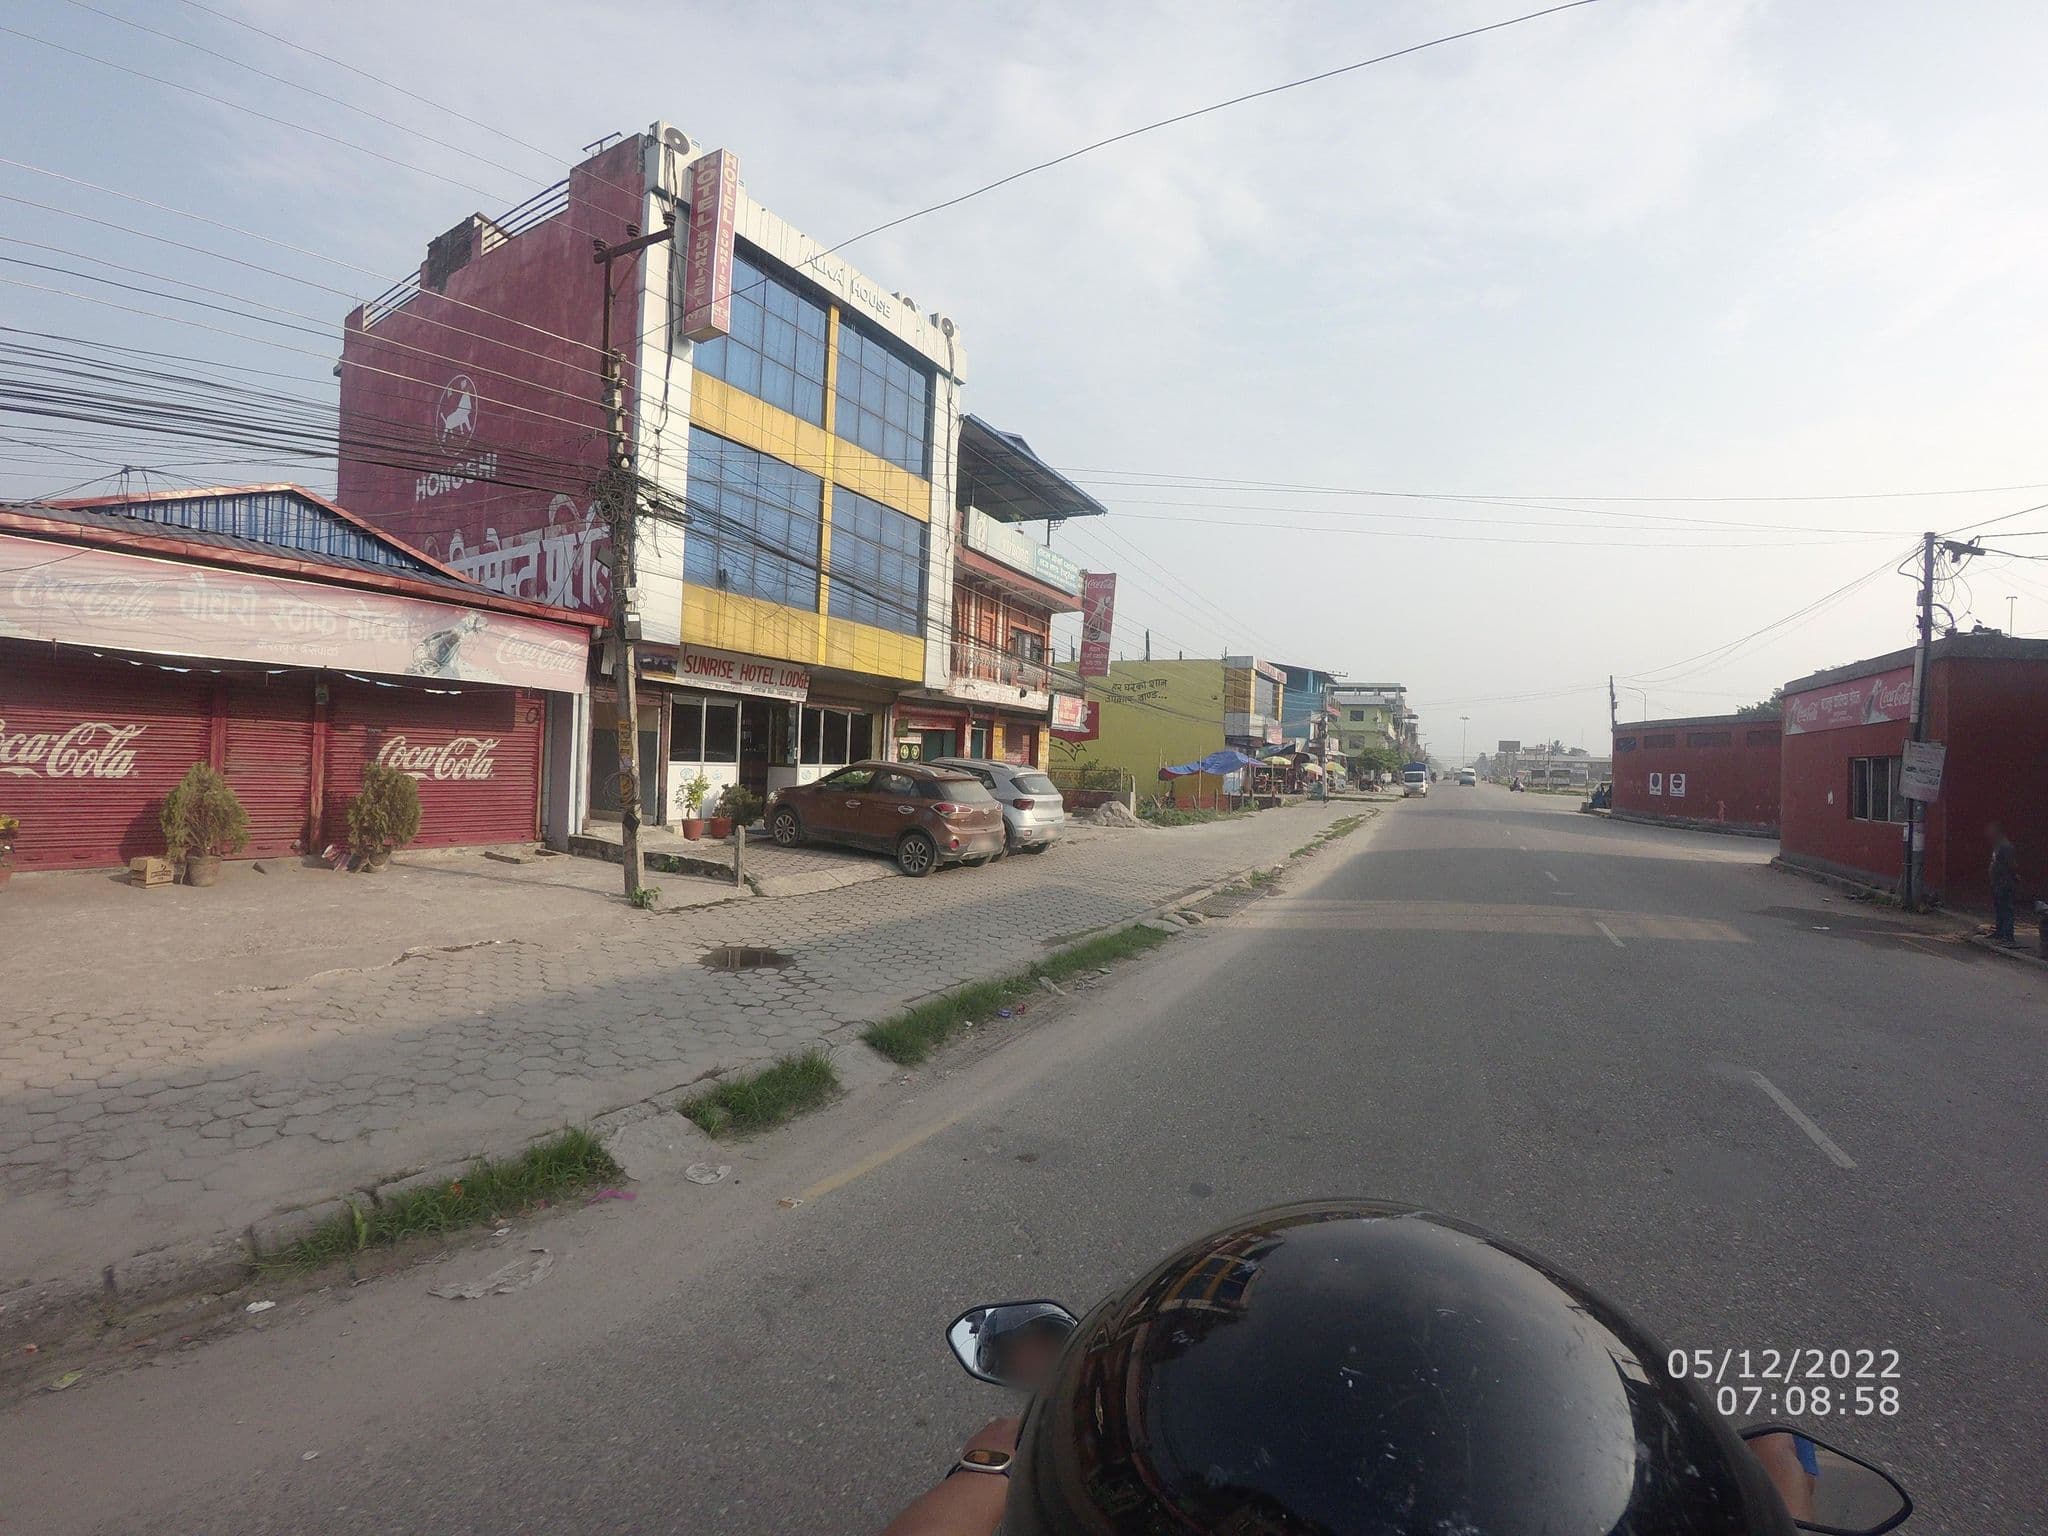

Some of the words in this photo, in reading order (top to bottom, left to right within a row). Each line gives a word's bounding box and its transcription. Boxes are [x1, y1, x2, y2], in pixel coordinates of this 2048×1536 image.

[696, 153, 719, 227] HOTEL
[722, 152, 737, 225] HOTEL
[851, 279, 892, 319] HOUSE
[685, 655, 735, 679] SUNRISE
[780, 669, 812, 690] LODGE
[376, 735, 501, 781] Coca-Cola
